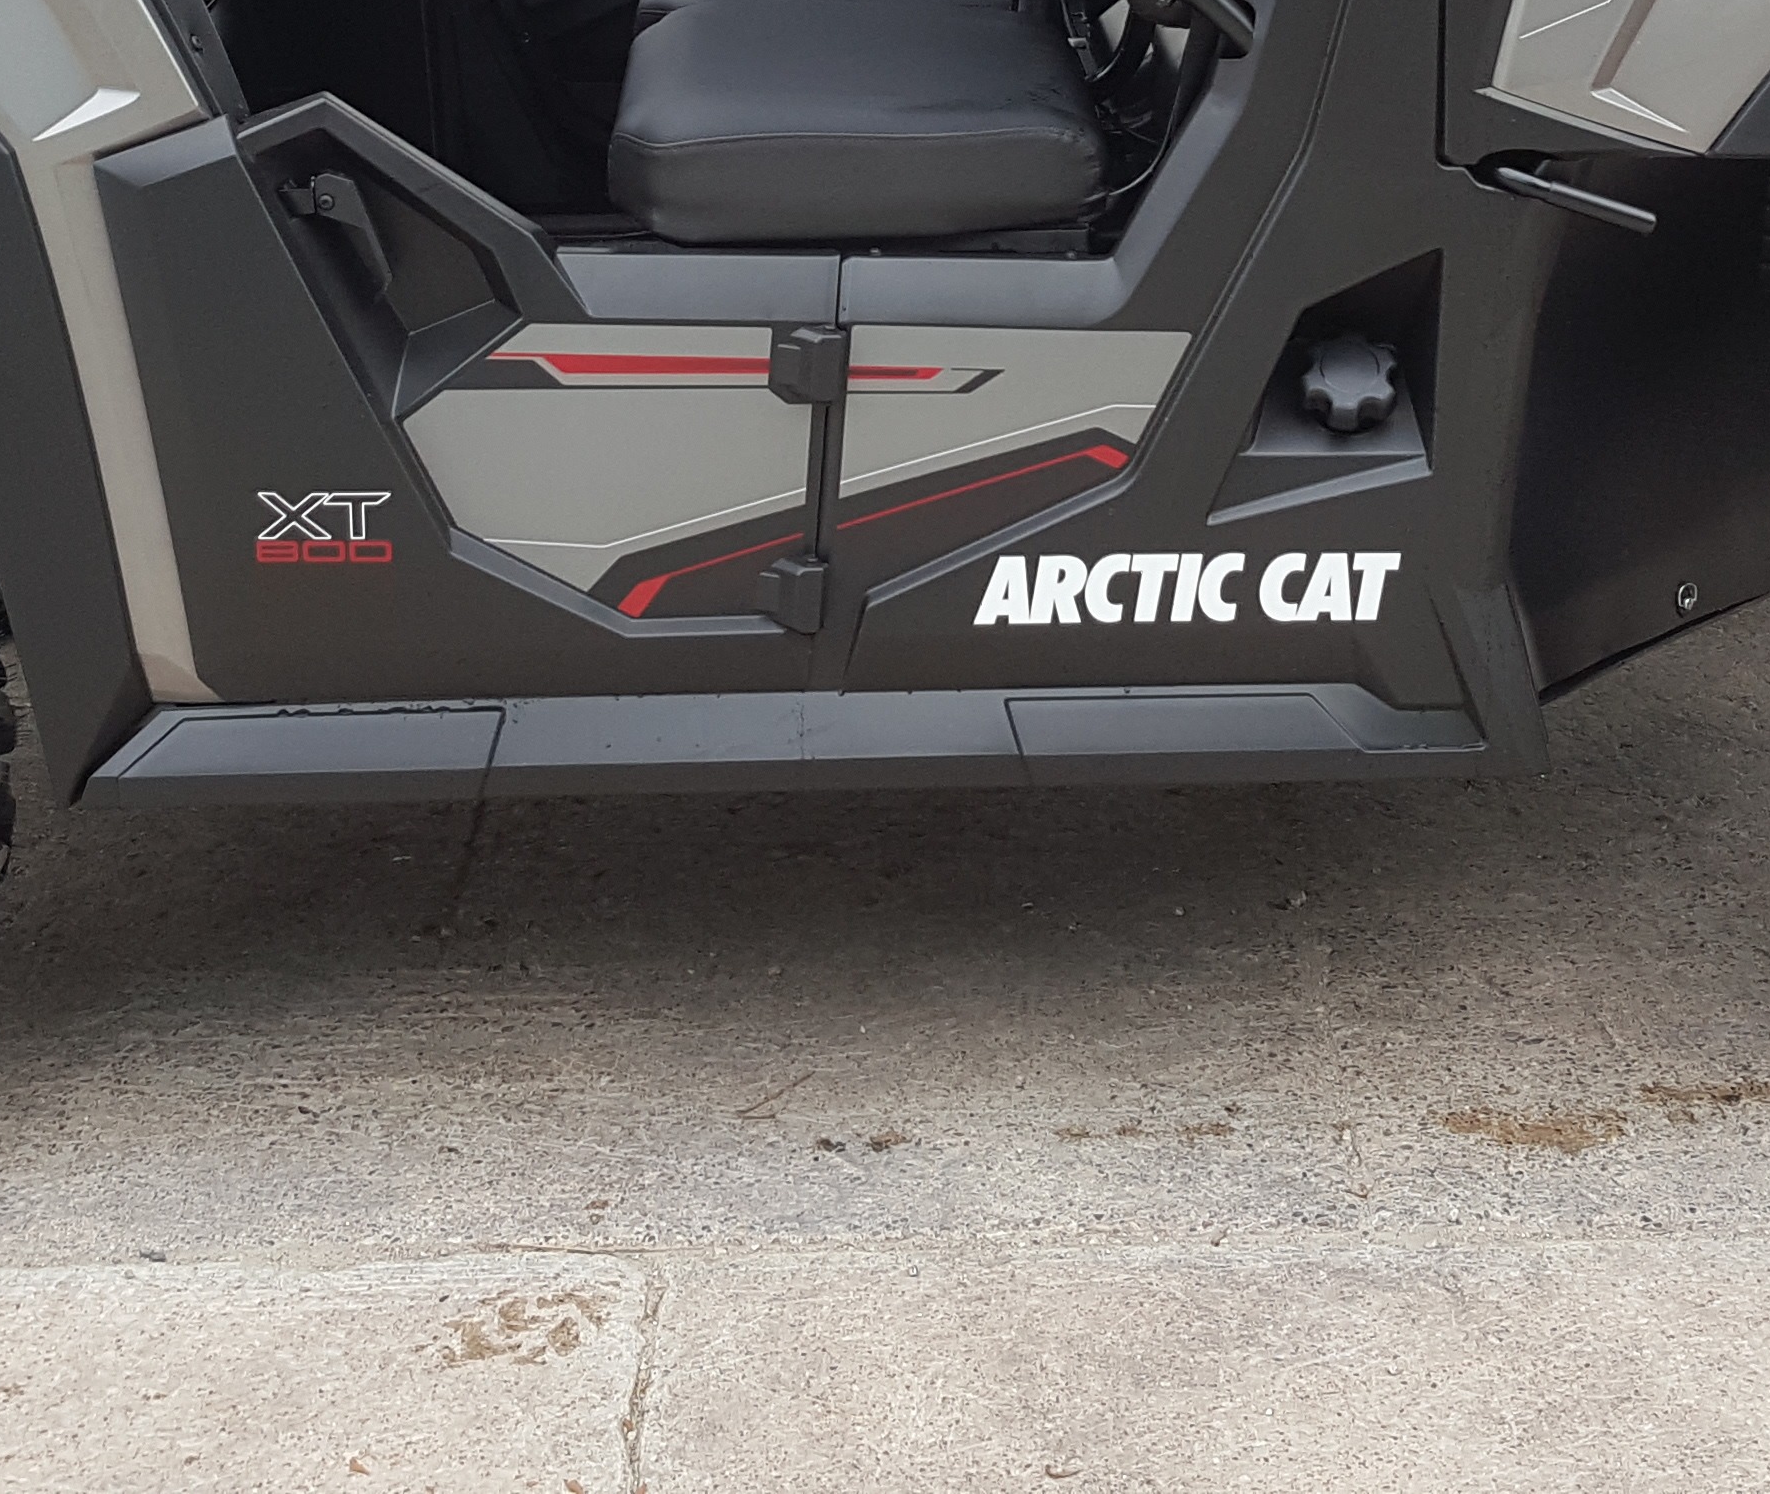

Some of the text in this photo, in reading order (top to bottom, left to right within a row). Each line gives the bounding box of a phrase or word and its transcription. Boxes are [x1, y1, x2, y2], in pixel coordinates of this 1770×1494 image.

[257, 491, 392, 541] XT
[256, 540, 393, 563] 800
[972, 551, 1402, 626] ARCTIC CAT
